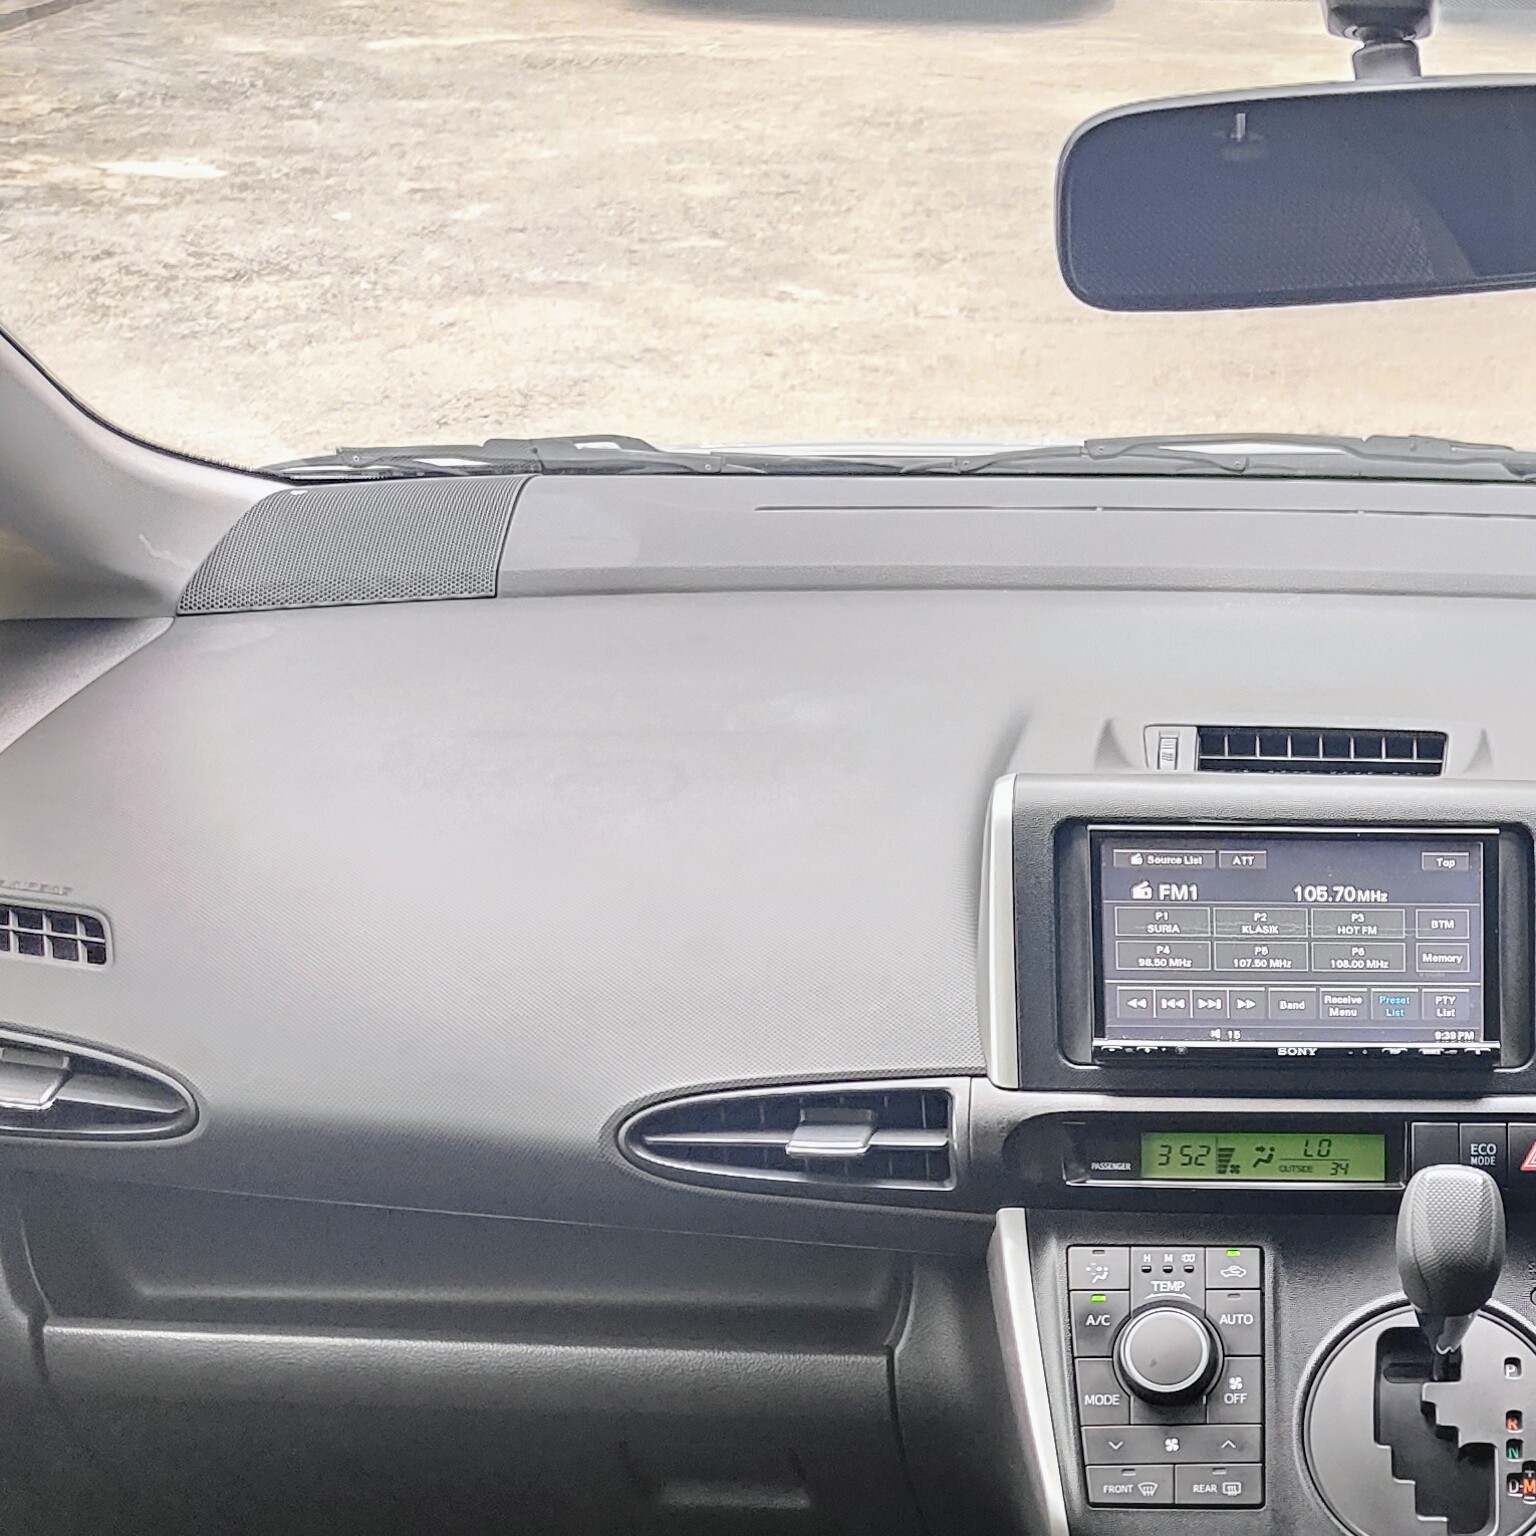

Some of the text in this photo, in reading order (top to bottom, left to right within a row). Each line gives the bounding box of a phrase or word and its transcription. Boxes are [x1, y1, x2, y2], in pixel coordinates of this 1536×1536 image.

[1147, 856, 1202, 865] Source List
[1232, 856, 1254, 866] ATT
[1436, 857, 1456, 868] Top
[1158, 884, 1198, 900] FM1
[1156, 912, 1169, 920] P1
[1254, 913, 1268, 922] P2
[1351, 914, 1364, 922] P3
[1431, 920, 1454, 929] BTM
[1147, 925, 1180, 934] SURIA
[1242, 926, 1278, 934] KLASIK
[1337, 926, 1377, 935] HOT FM
[1156, 946, 1170, 954] P4
[1169, 958, 1192, 968] MHz
[1270, 959, 1292, 968] MHz
[1366, 960, 1389, 968] MHz
[1422, 953, 1463, 966] Memory
[1324, 996, 1362, 1004] Receive
[1380, 996, 1410, 1005] Preset
[1435, 996, 1456, 1005] PTY
[1280, 1000, 1306, 1010] Band
[1329, 1008, 1357, 1017] Menu
[1386, 1008, 1404, 1017] List
[1436, 1008, 1456, 1017] List
[1458, 1031, 1475, 1040] PM
[1278, 1047, 1318, 1056] SONY
[1470, 1143, 1496, 1156] ECO
[1470, 1156, 1496, 1166] MODE
[1091, 1162, 1132, 1170] PASSENGER
[1278, 1164, 1313, 1173] OUTSIDE
[1330, 1162, 1349, 1176] 34
[1143, 1253, 1152, 1262] H
[1164, 1253, 1174, 1262] M
[1150, 1280, 1186, 1292] TEMP
[1086, 1314, 1110, 1326] A/C
[1220, 1314, 1254, 1324] AUTO
[1506, 1364, 1516, 1376] P
[1084, 1394, 1120, 1406] MODE
[1224, 1393, 1247, 1404] OFF
[1508, 1418, 1518, 1430] R
[1508, 1448, 1518, 1458] N
[1103, 1485, 1134, 1494] FRONT
[1192, 1484, 1217, 1493] REAR
